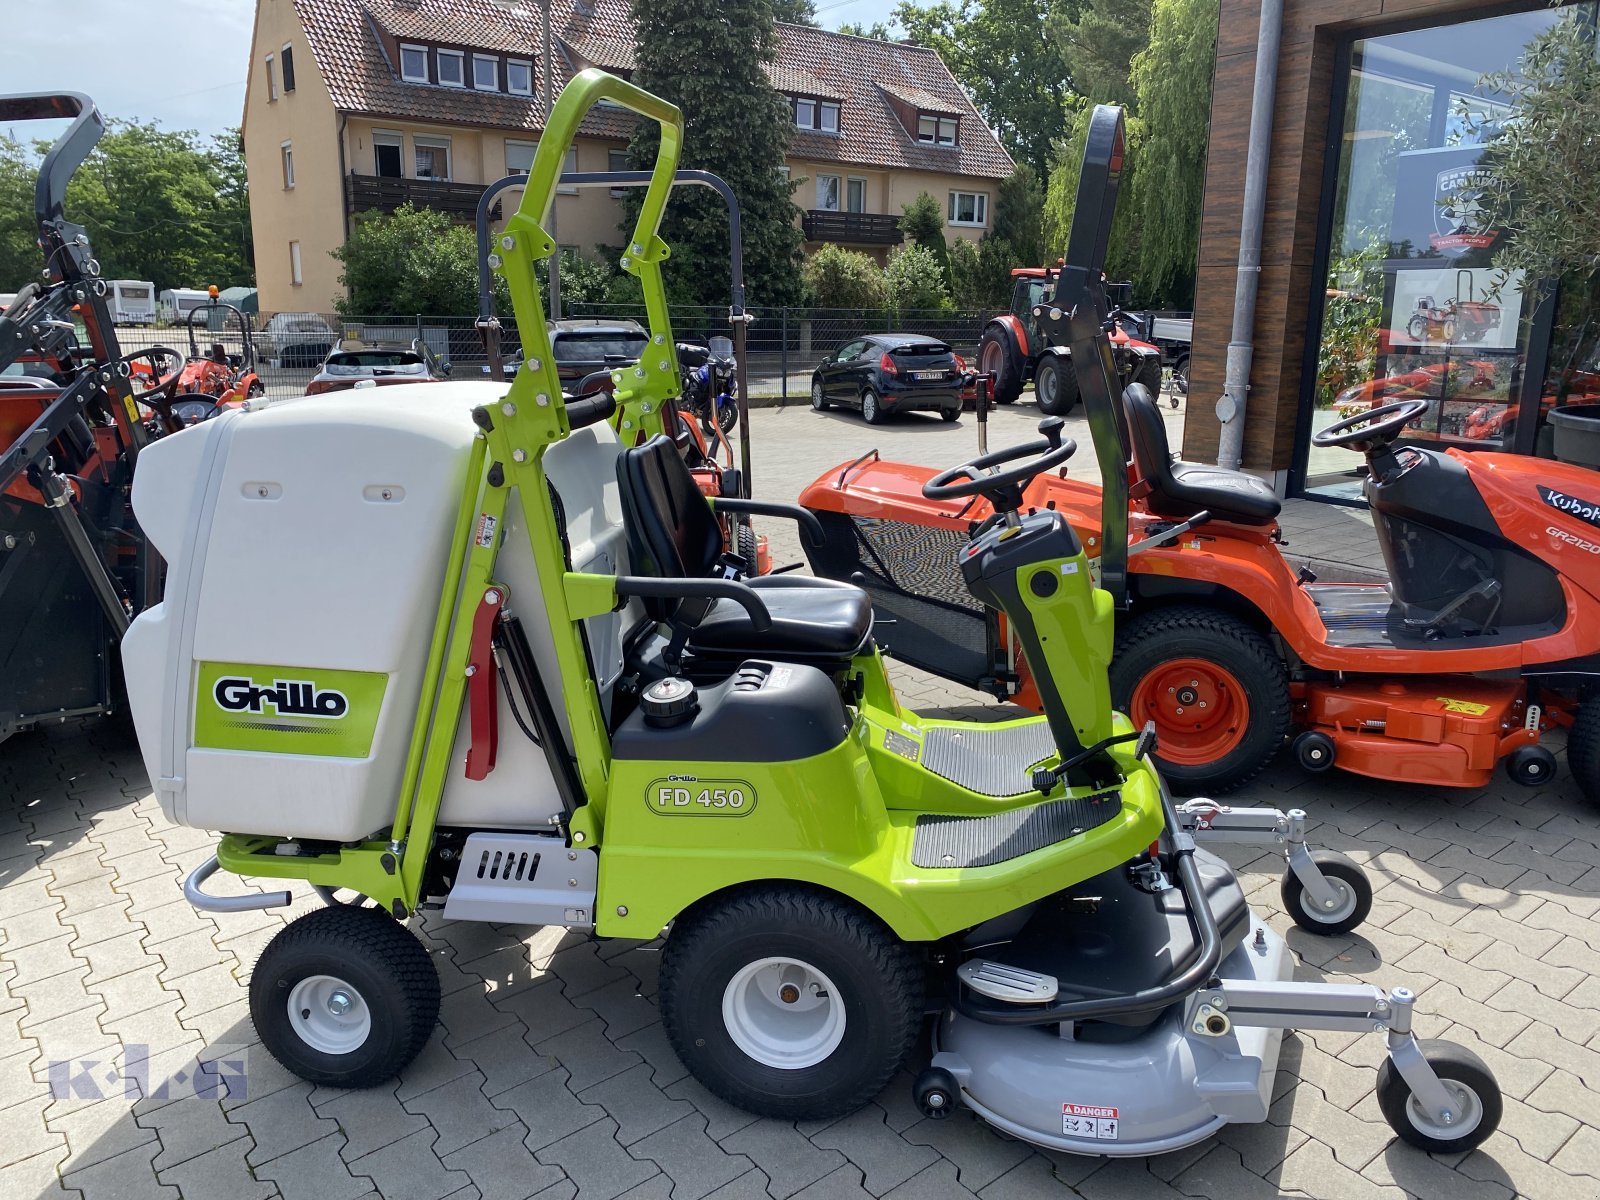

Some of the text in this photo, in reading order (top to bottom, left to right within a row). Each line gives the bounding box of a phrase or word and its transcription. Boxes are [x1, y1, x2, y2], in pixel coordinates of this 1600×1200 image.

[1441, 170, 1499, 182] ANTONI
[1545, 526, 1600, 554] GR2120
[214, 677, 348, 718] Grillo
[659, 788, 744, 808] FD 450
[1073, 1106, 1114, 1117] DANGER
